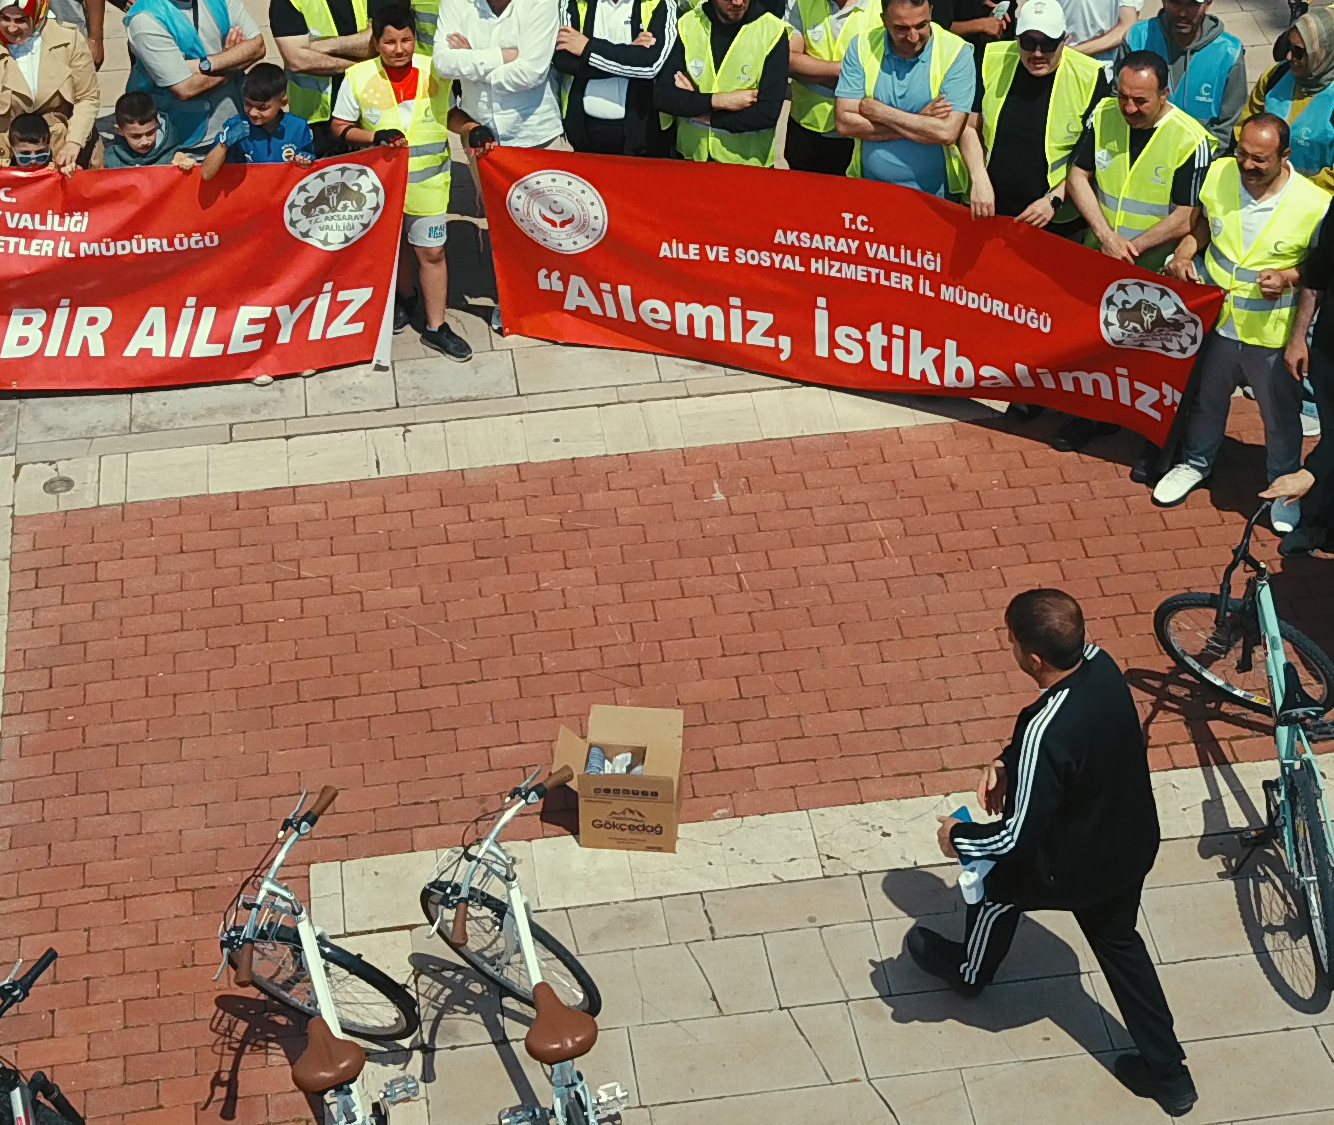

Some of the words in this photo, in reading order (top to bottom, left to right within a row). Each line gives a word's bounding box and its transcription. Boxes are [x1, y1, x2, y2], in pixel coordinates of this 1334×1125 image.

[5, 210, 89, 233] VALİLİĞİ
[841, 213, 875, 233] T.C.
[57, 237, 75, 258] İL
[79, 232, 219, 258] MÜDÜRLÜĞÜ
[773, 229, 859, 255] AKSARAY
[865, 241, 941, 273] VALİLİĞİ
[659, 238, 701, 261] AİLE
[705, 244, 730, 263] VE
[734, 247, 805, 272] SOSYAL
[811, 257, 914, 292] HİZMETLER
[919, 274, 935, 298] İL
[940, 284, 1052, 334] MÜDÜRLÜĞÜ
[0, 298, 112, 358] BİR
[121, 282, 373, 358] AİLEYİZ
[591, 818, 664, 836] Gökçedağ
